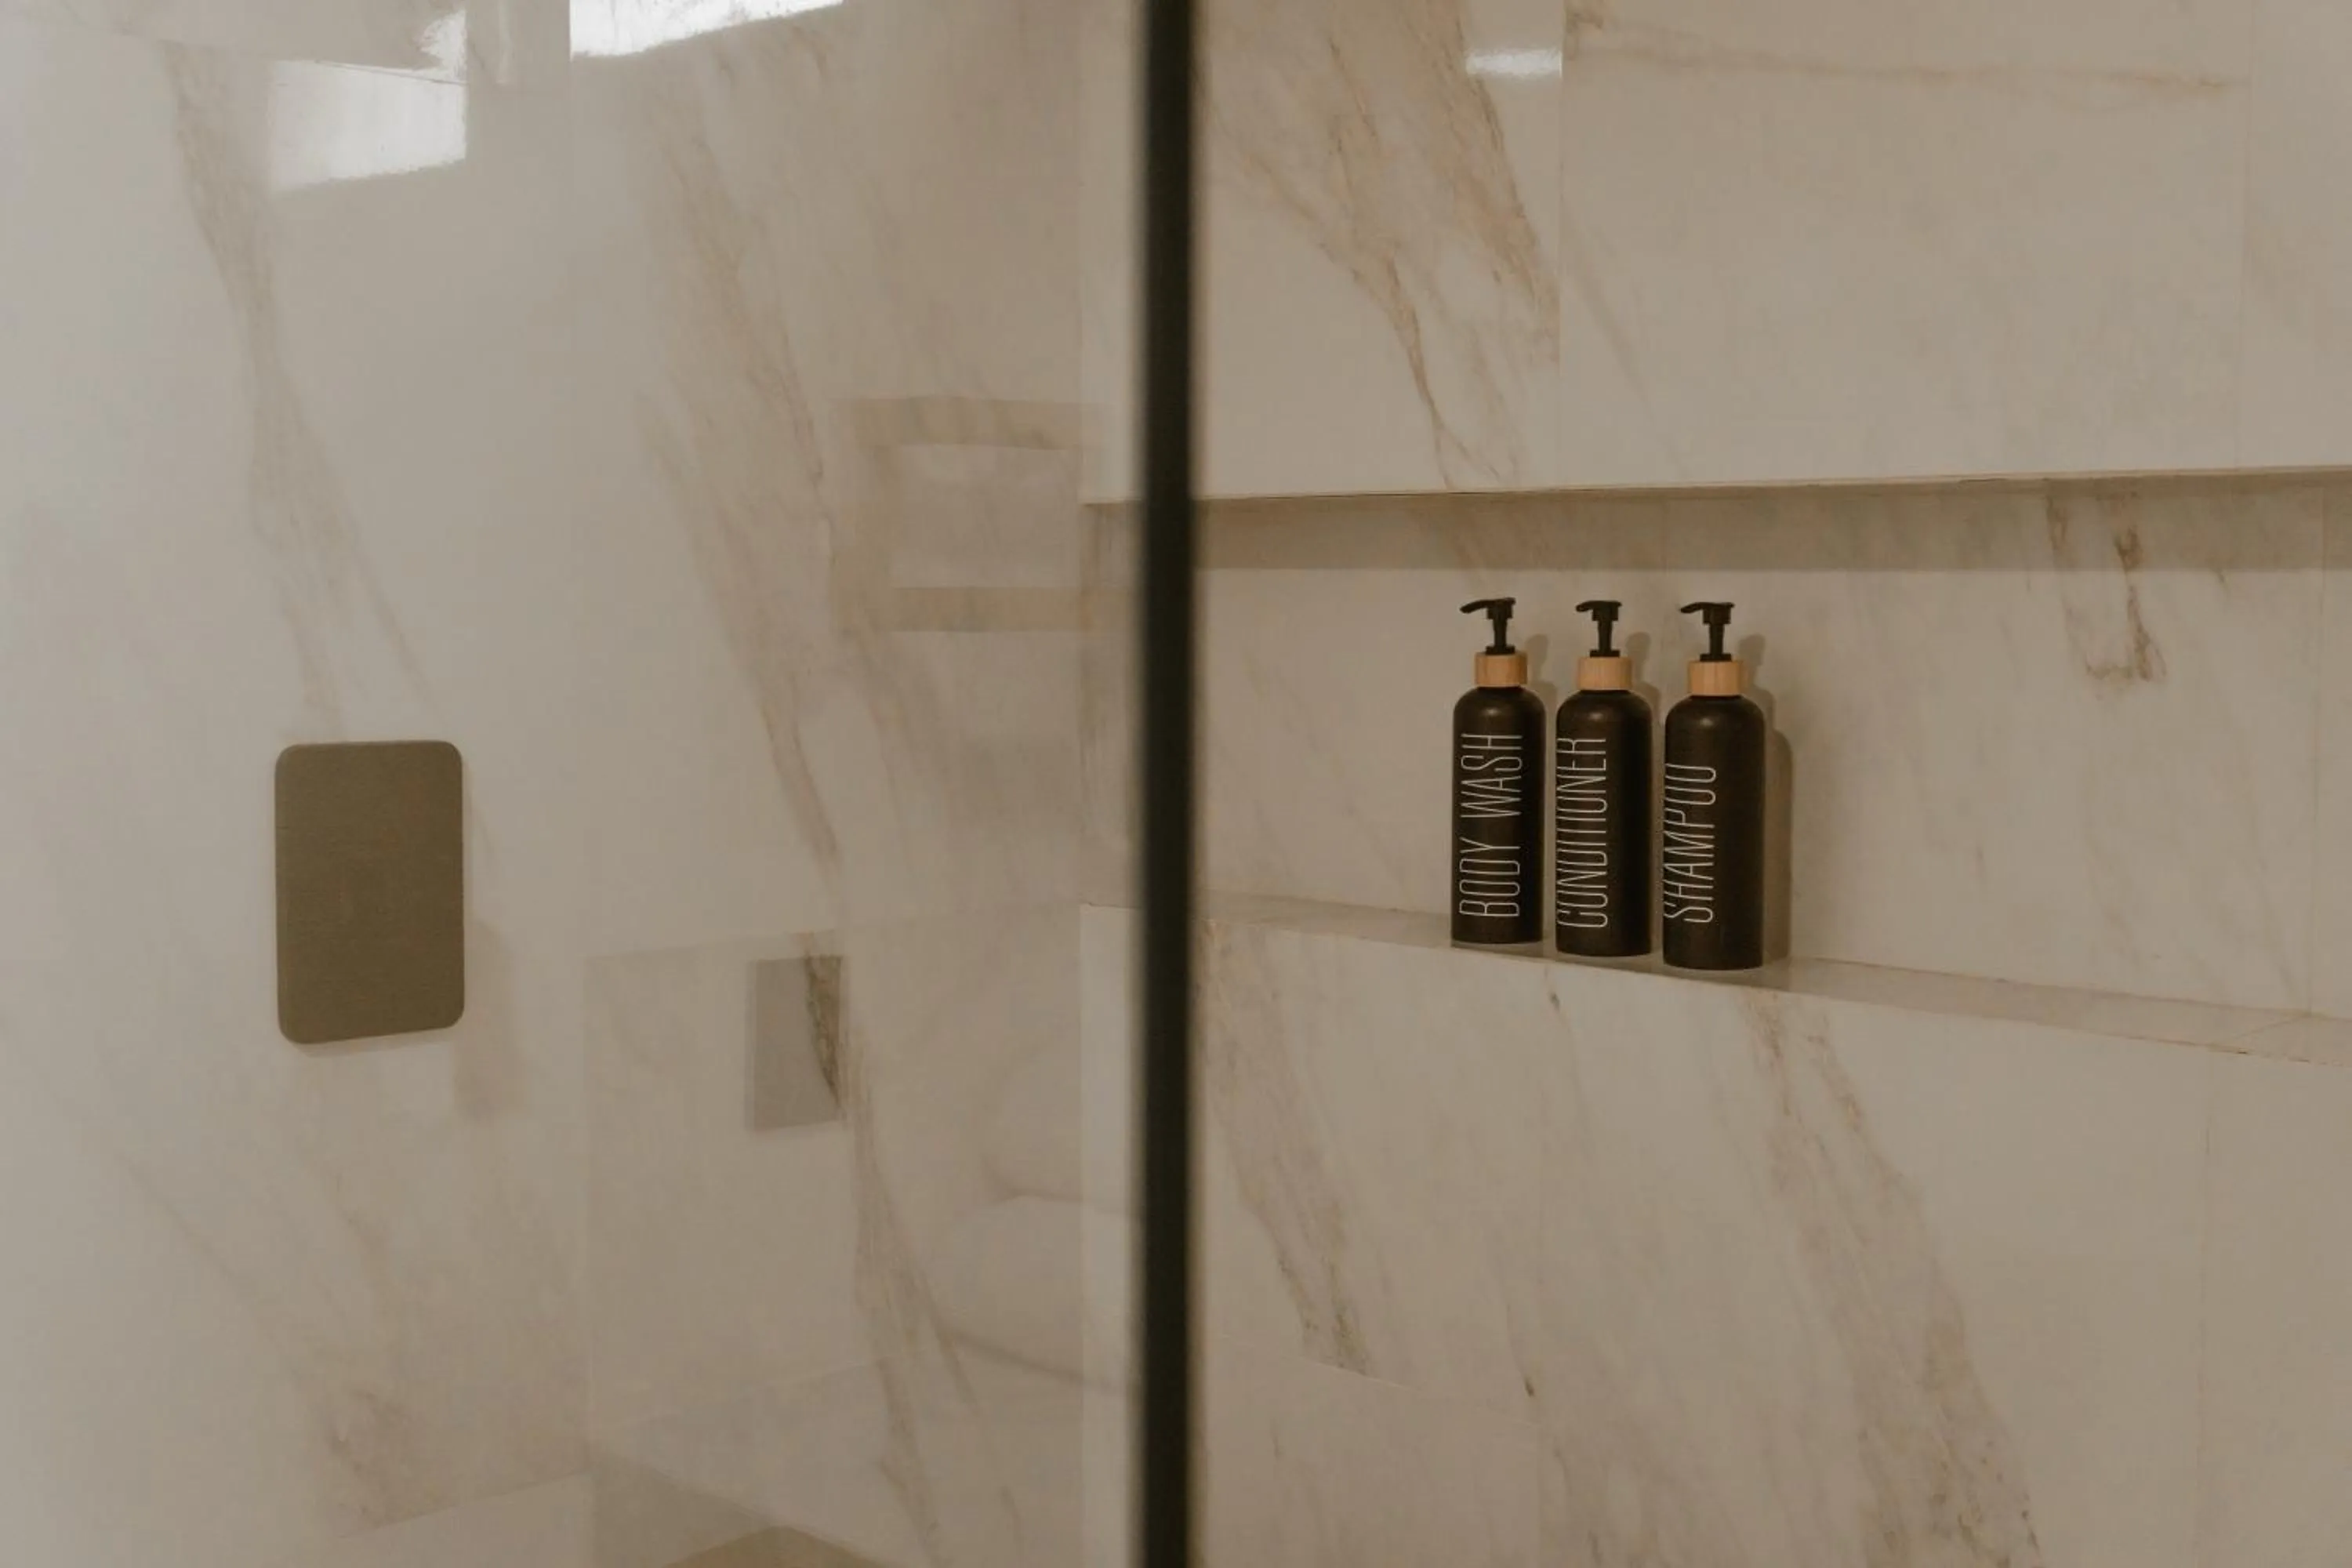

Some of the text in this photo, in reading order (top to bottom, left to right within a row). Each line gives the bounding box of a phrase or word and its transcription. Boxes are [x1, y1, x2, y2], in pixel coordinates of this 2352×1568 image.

[1459, 733, 1523, 917] BODY WASH
[1556, 737, 1608, 928] CONDITIONER
[1663, 762, 1717, 924] SHAMPOO
